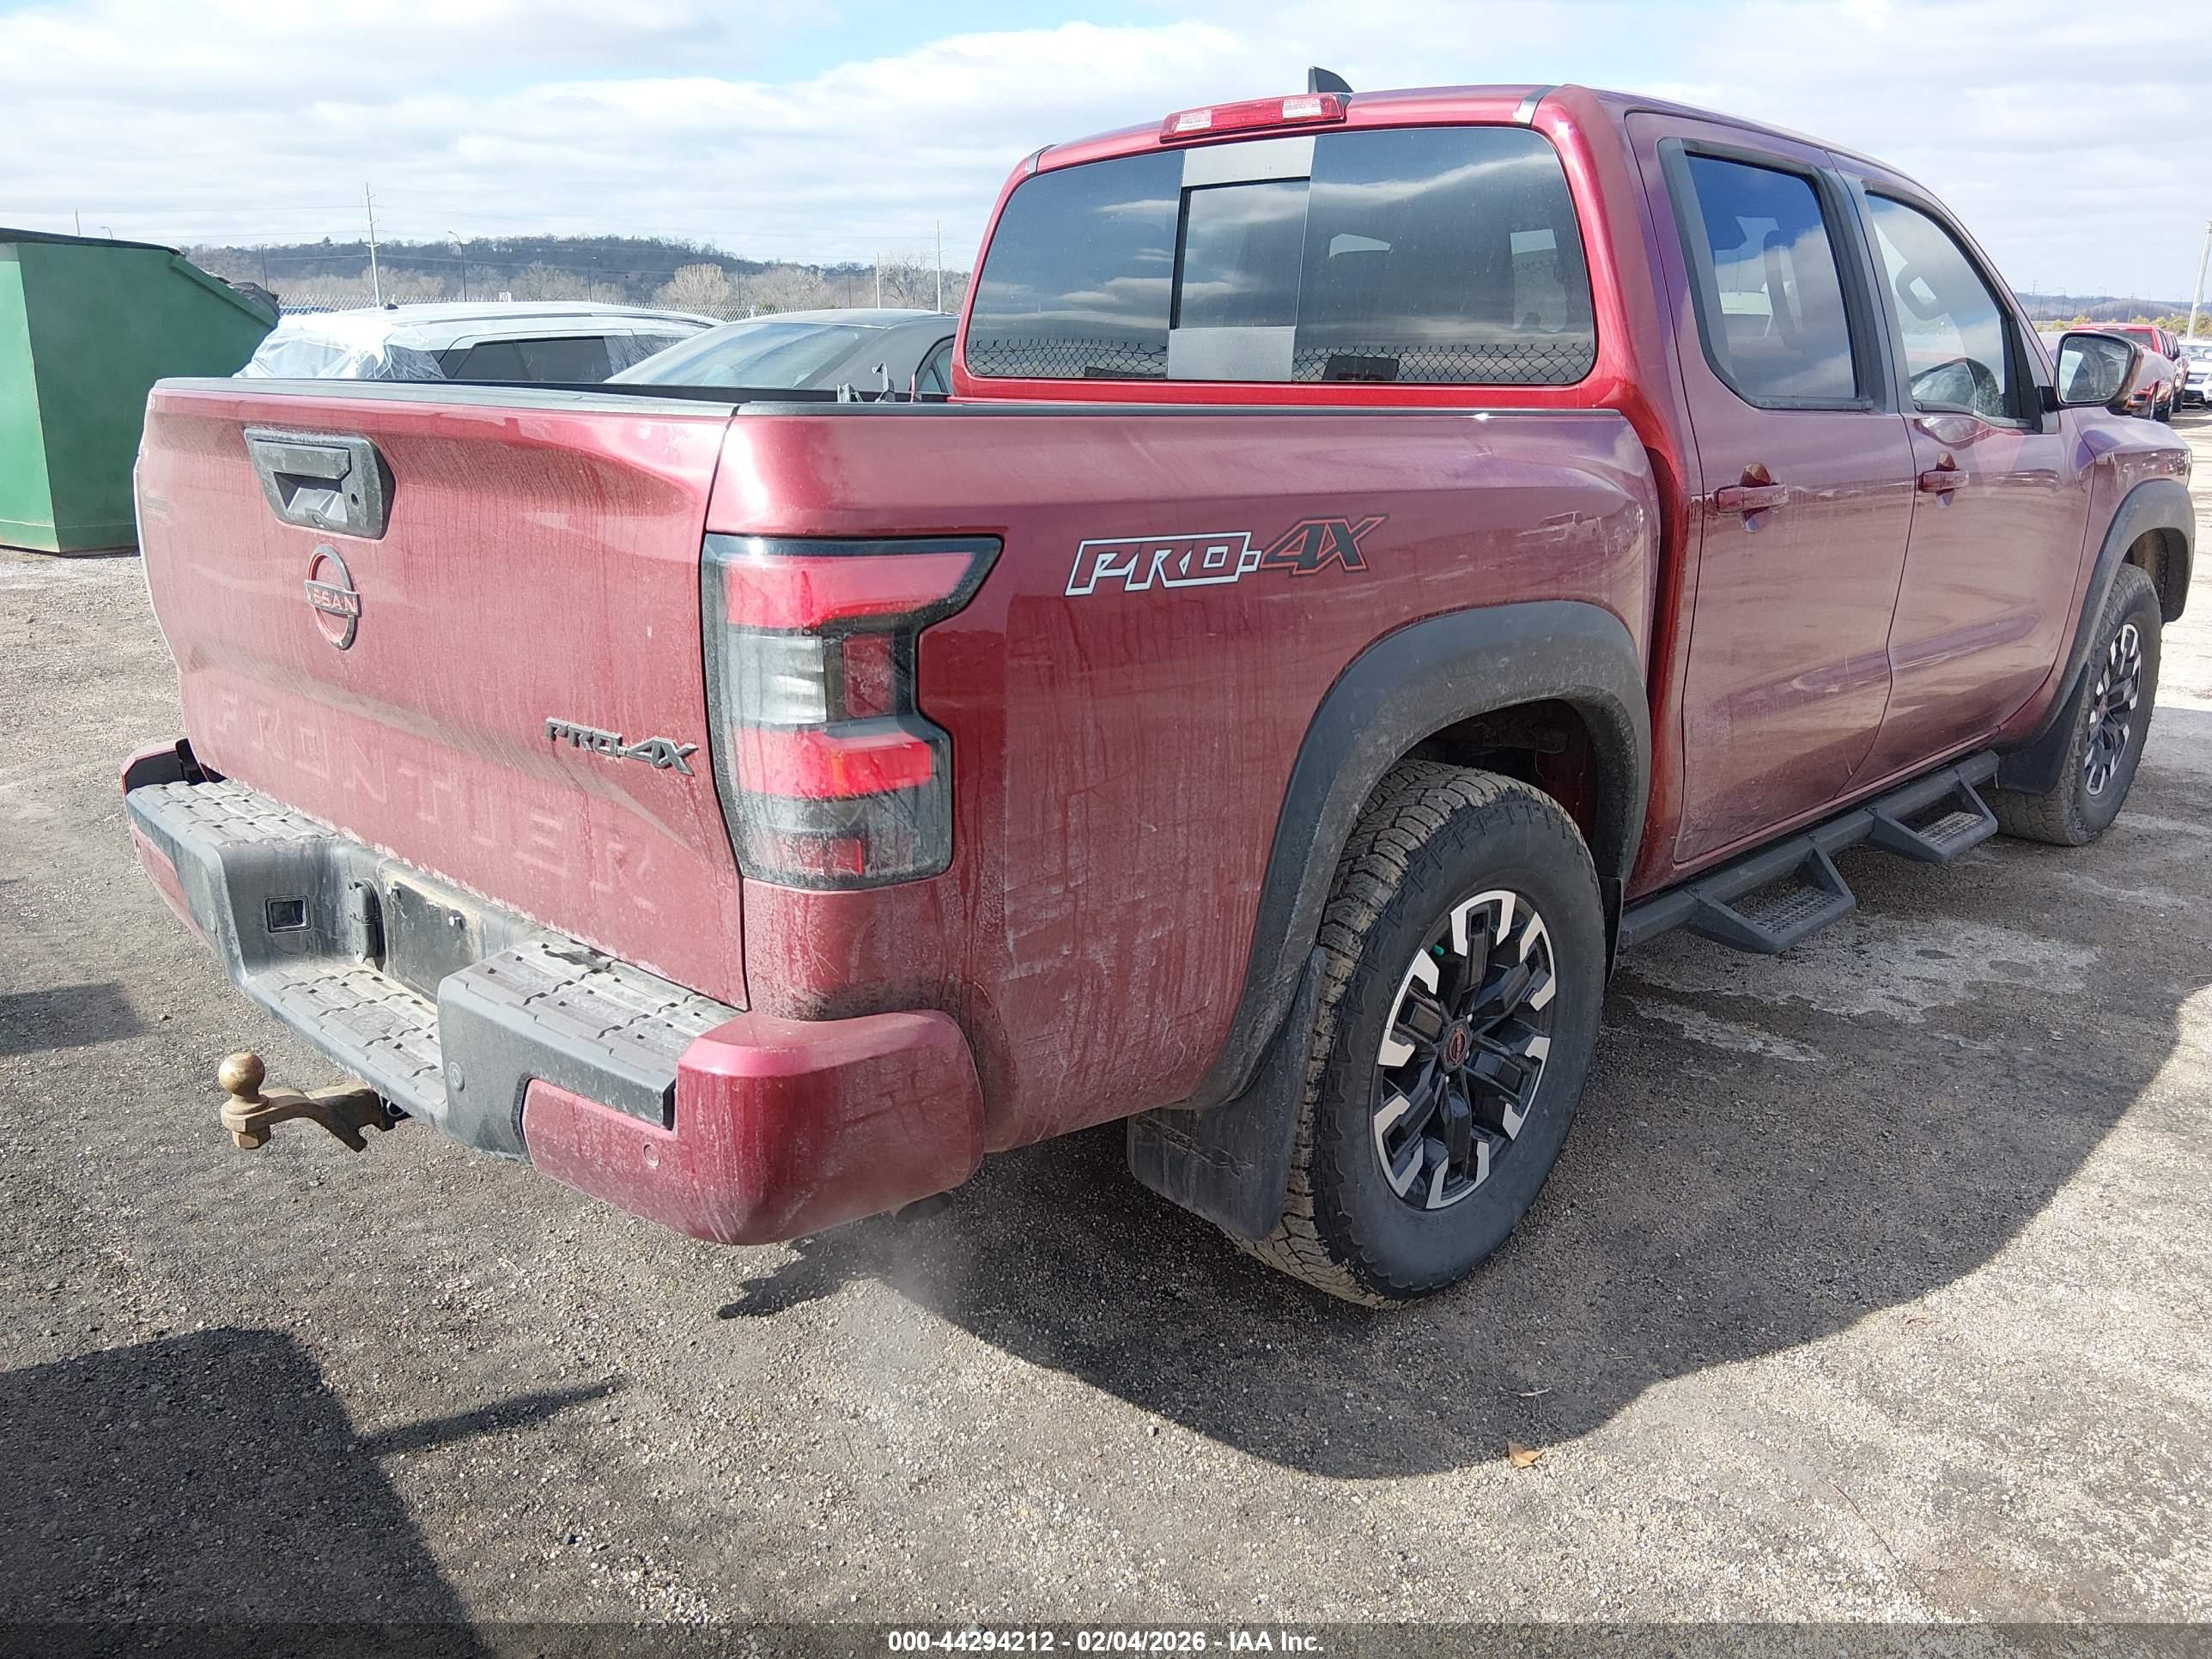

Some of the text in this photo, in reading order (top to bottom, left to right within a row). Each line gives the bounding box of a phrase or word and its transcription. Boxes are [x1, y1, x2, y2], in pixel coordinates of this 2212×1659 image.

[1064, 514, 1389, 597] PRO-4X
[306, 584, 358, 615] SSAN
[544, 716, 699, 777] PRO-4X
